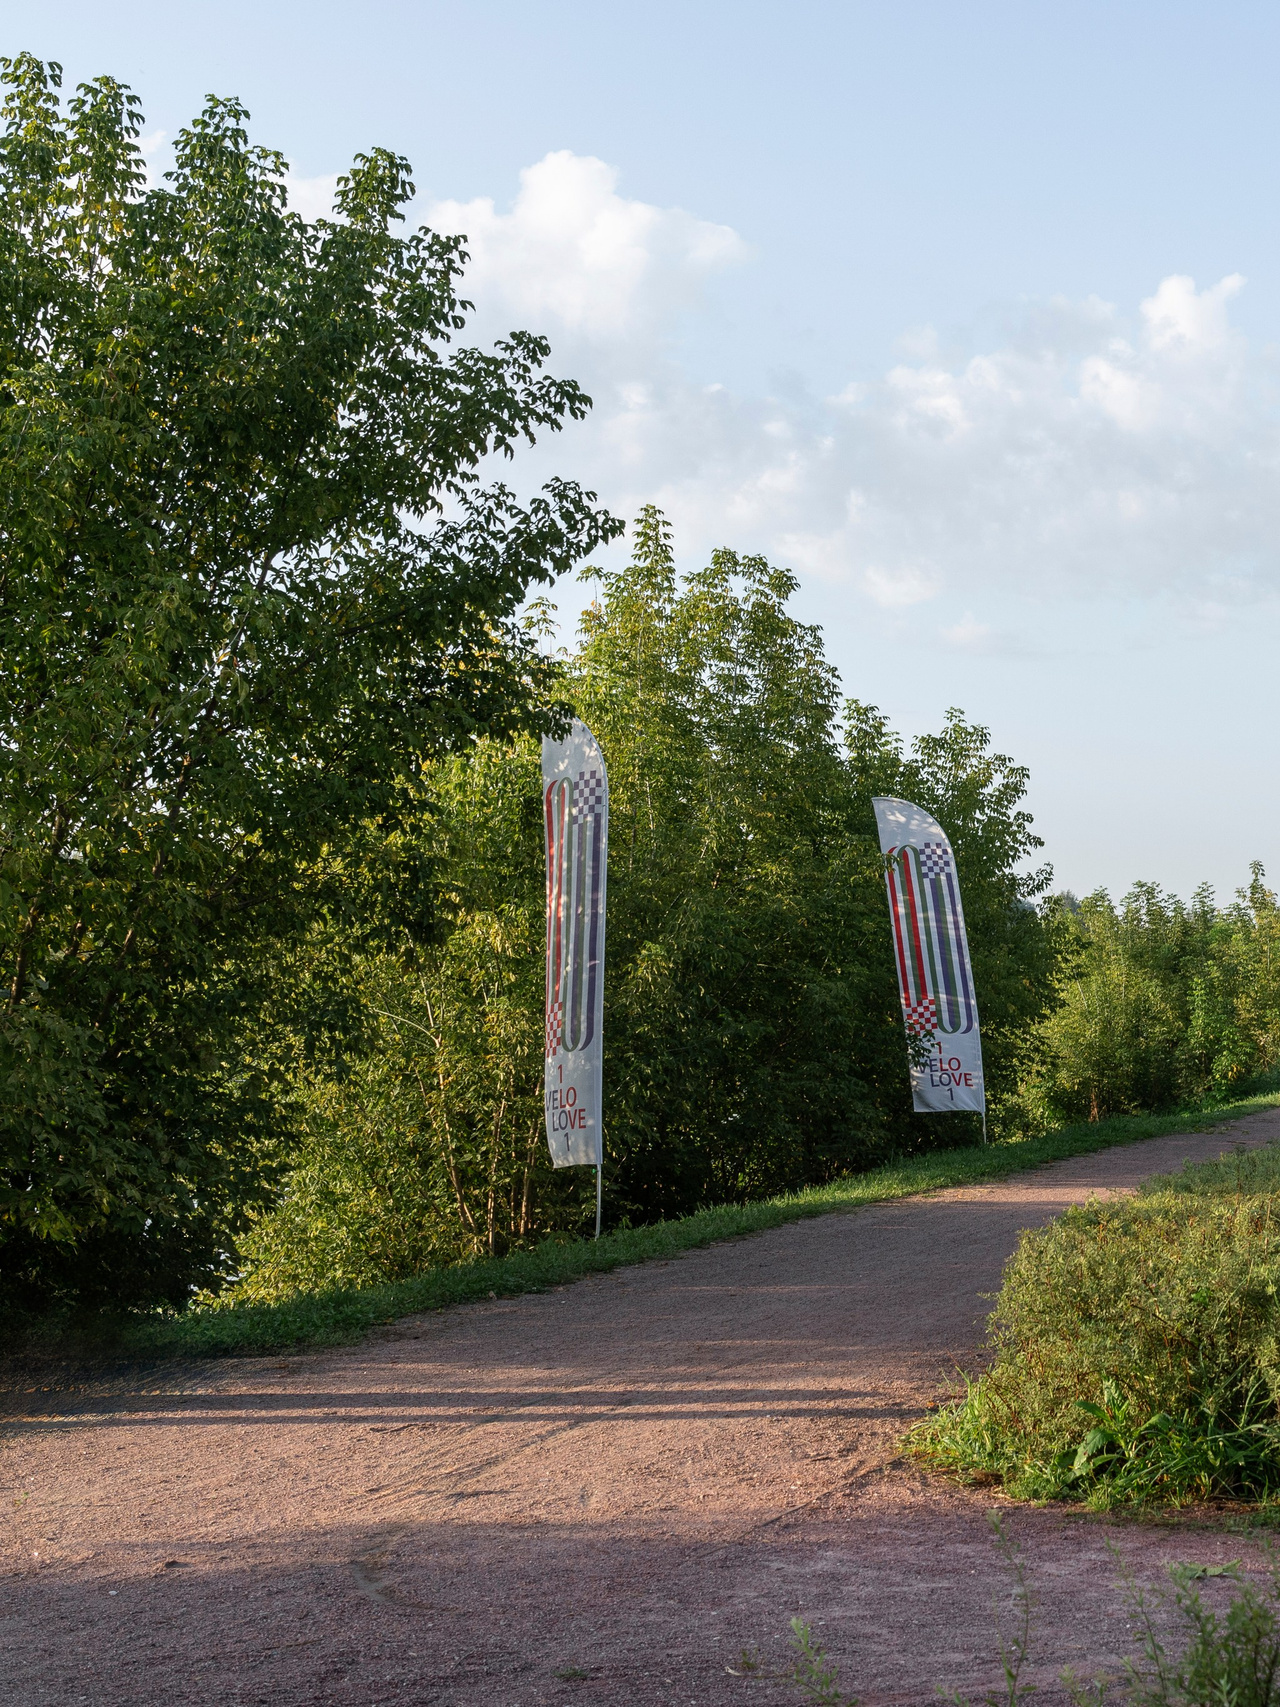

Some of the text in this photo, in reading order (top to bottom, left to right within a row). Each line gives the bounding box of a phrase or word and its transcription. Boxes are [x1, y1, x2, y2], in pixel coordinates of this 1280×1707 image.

[937, 1041, 942, 1055] 1
[558, 1064, 563, 1083] 1
[930, 1072, 973, 1087] LOVE
[545, 1086, 577, 1112] VELO
[947, 1087, 954, 1101] 1
[552, 1108, 587, 1132] LOVE
[564, 1132, 570, 1151] 1
